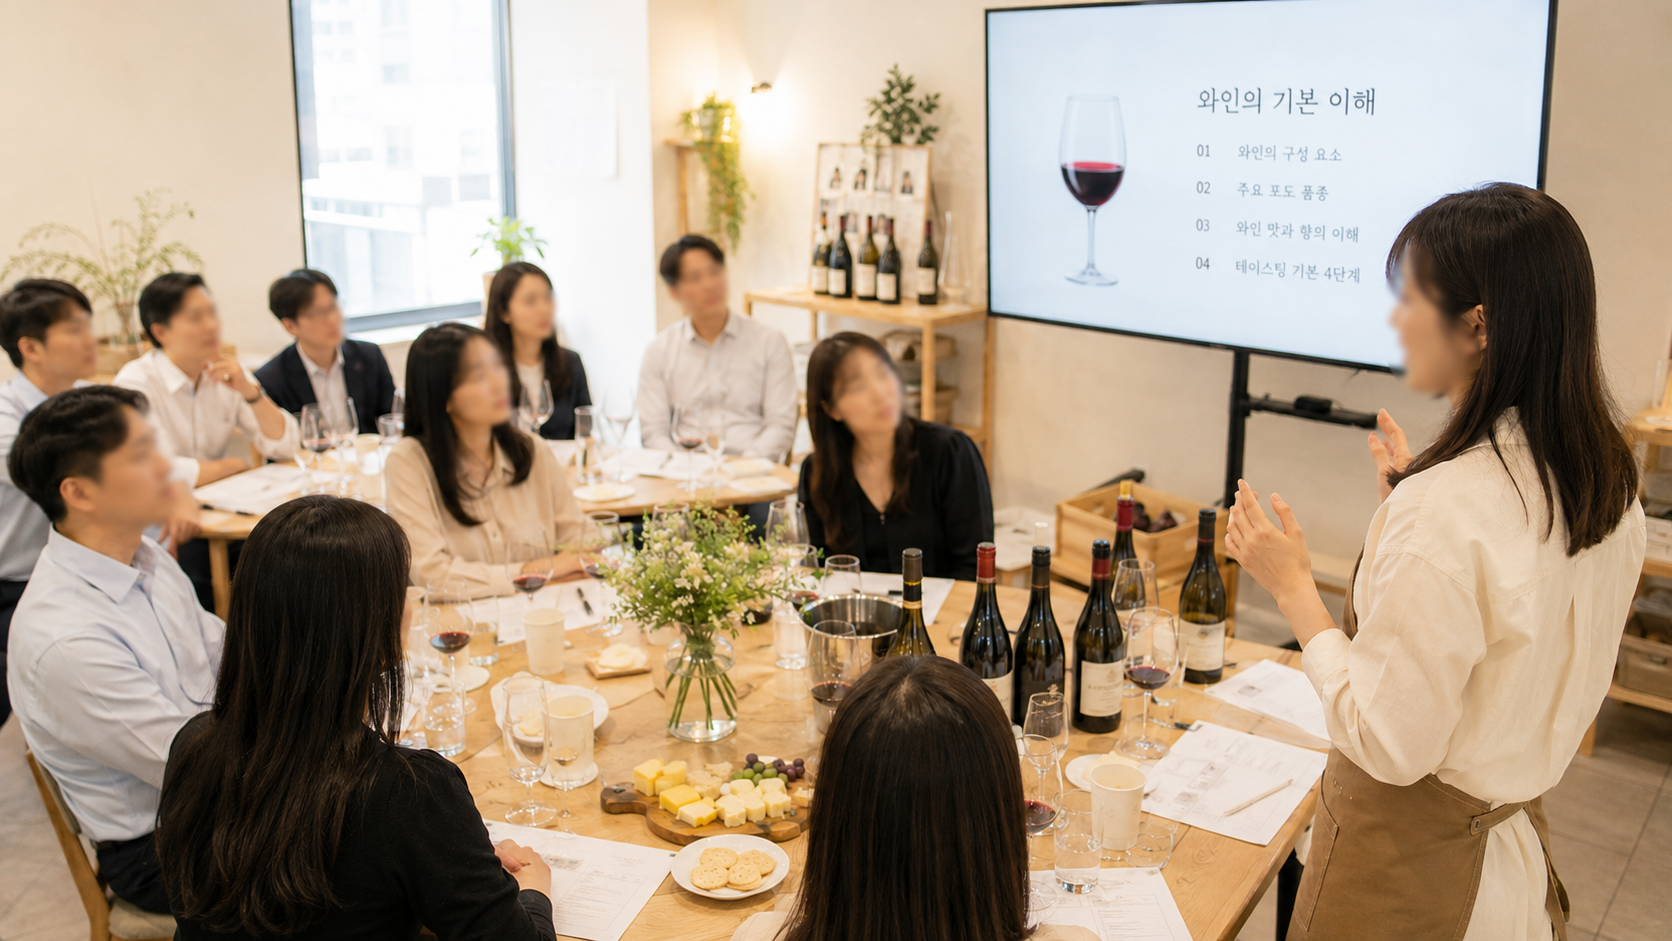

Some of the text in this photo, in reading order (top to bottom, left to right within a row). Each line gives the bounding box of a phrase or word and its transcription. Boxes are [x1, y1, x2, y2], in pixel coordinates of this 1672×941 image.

[1197, 87, 1375, 116] 와인의 기본 이해
[1197, 144, 1342, 162] 01 와인의 구성 요소
[1196, 181, 1329, 201] 02 주요 포도 품종
[1196, 218, 1358, 243] 03 와인 맛과 향의 이해
[1196, 256, 1360, 283] 04 테이스팅 기본 4단계
